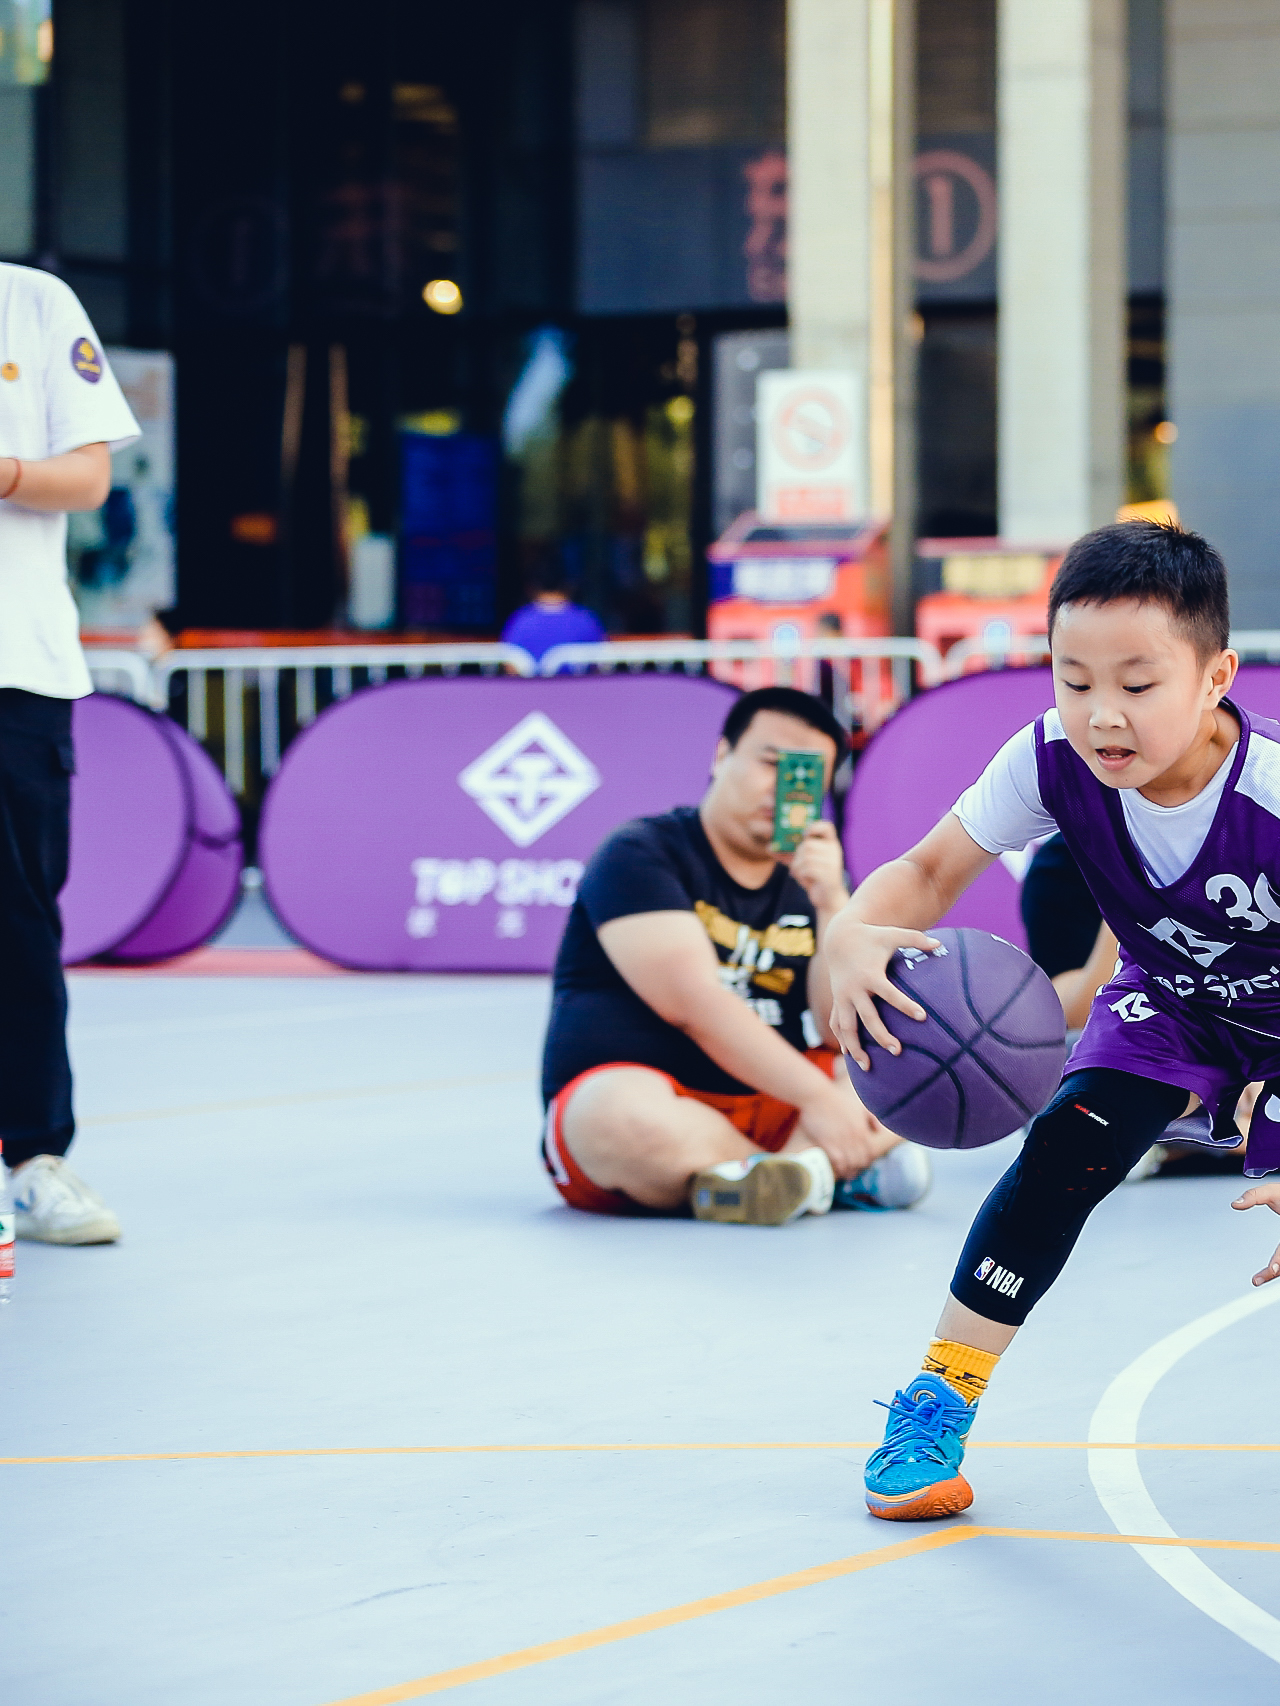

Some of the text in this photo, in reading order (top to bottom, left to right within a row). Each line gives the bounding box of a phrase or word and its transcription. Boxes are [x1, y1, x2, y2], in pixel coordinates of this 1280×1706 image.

[497, 858, 584, 907] SHO
[1108, 992, 1159, 1023] TS
[986, 1265, 1025, 1299] NBA
